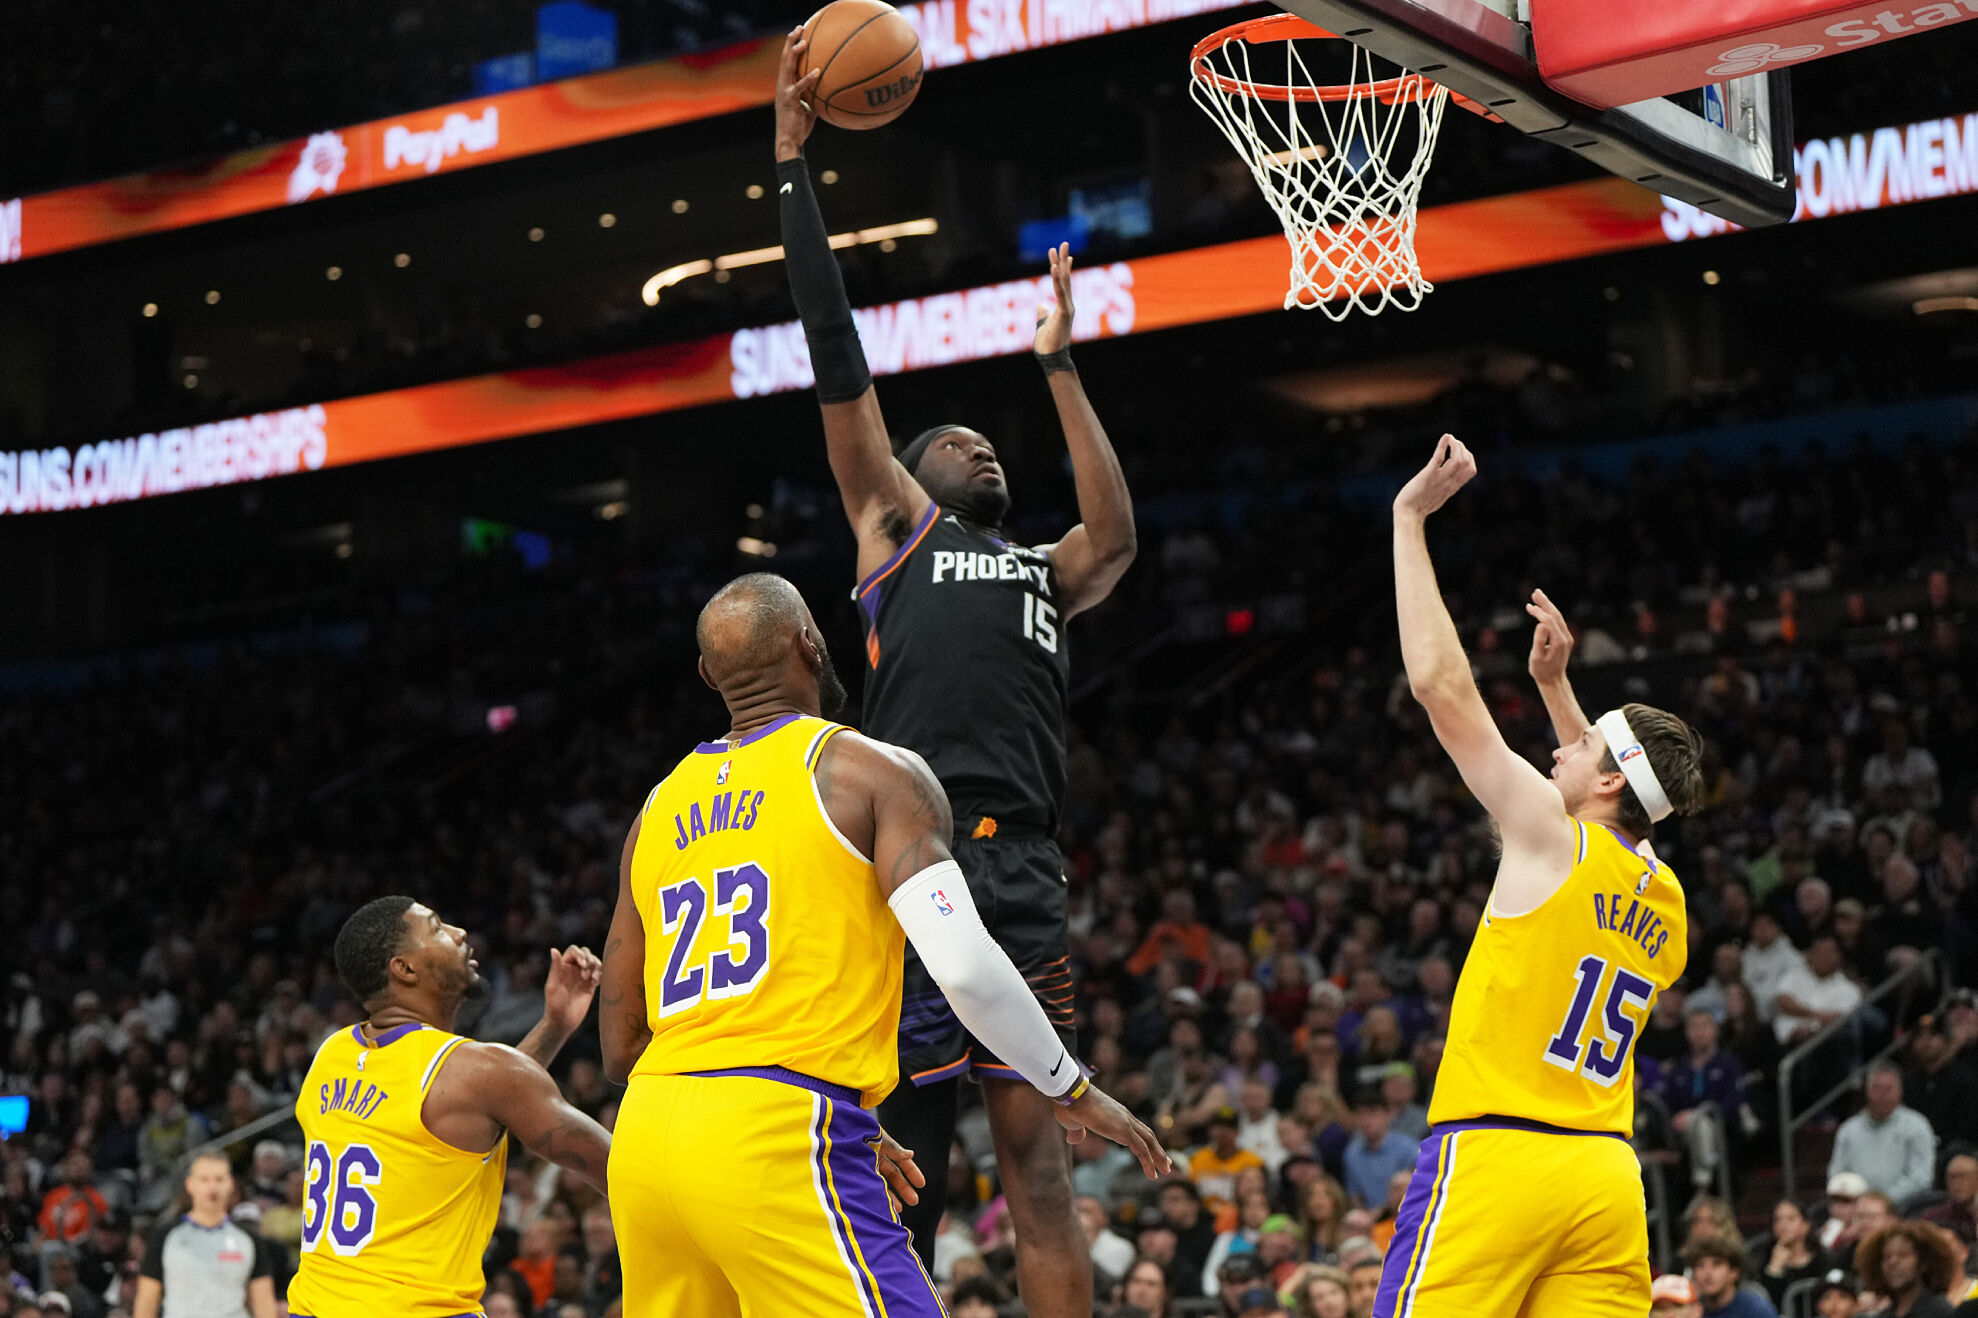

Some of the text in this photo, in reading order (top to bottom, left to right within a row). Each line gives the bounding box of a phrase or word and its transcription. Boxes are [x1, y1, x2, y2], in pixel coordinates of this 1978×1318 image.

[1824, 0, 1978, 47] Sta
[384, 105, 499, 174] PayPal
[1023, 591, 1058, 654] 15
[675, 789, 765, 851] JAMES
[658, 860, 770, 1019] 23
[1594, 893, 1669, 960] REAVES
[1542, 953, 1656, 1088] 15
[320, 1077, 389, 1120] SMART
[301, 1140, 383, 1257] 36
